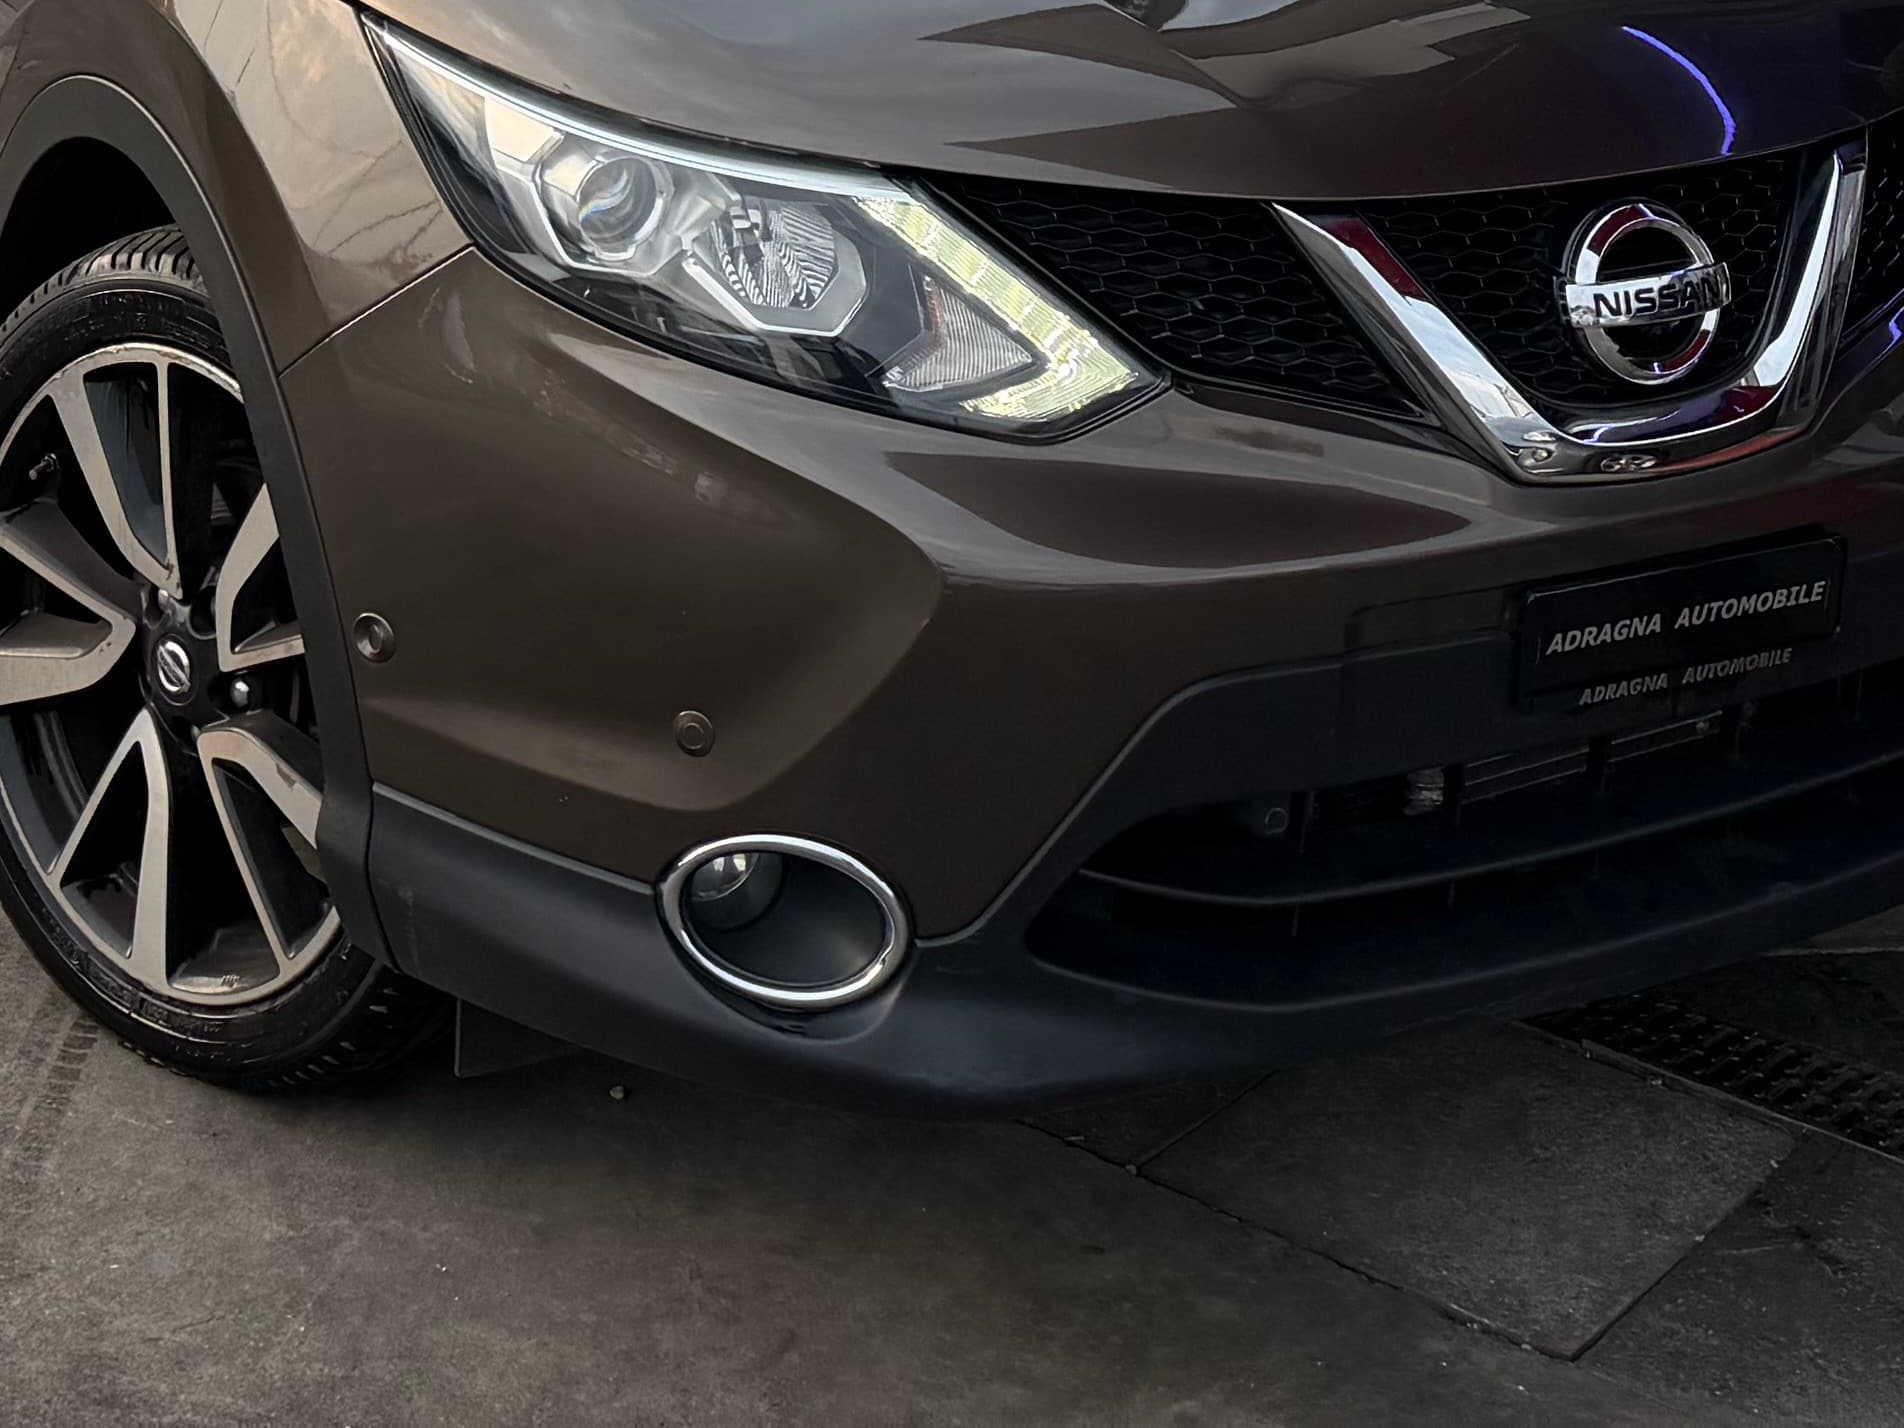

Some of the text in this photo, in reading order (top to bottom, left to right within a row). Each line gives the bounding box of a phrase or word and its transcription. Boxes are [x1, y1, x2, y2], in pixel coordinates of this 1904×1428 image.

[1593, 276, 1720, 317] NISSAN
[1546, 580, 1826, 655] ADRAGNA AUTOMOBILE
[1579, 648, 1793, 706] ADRAGNA AUTOMOBILE
